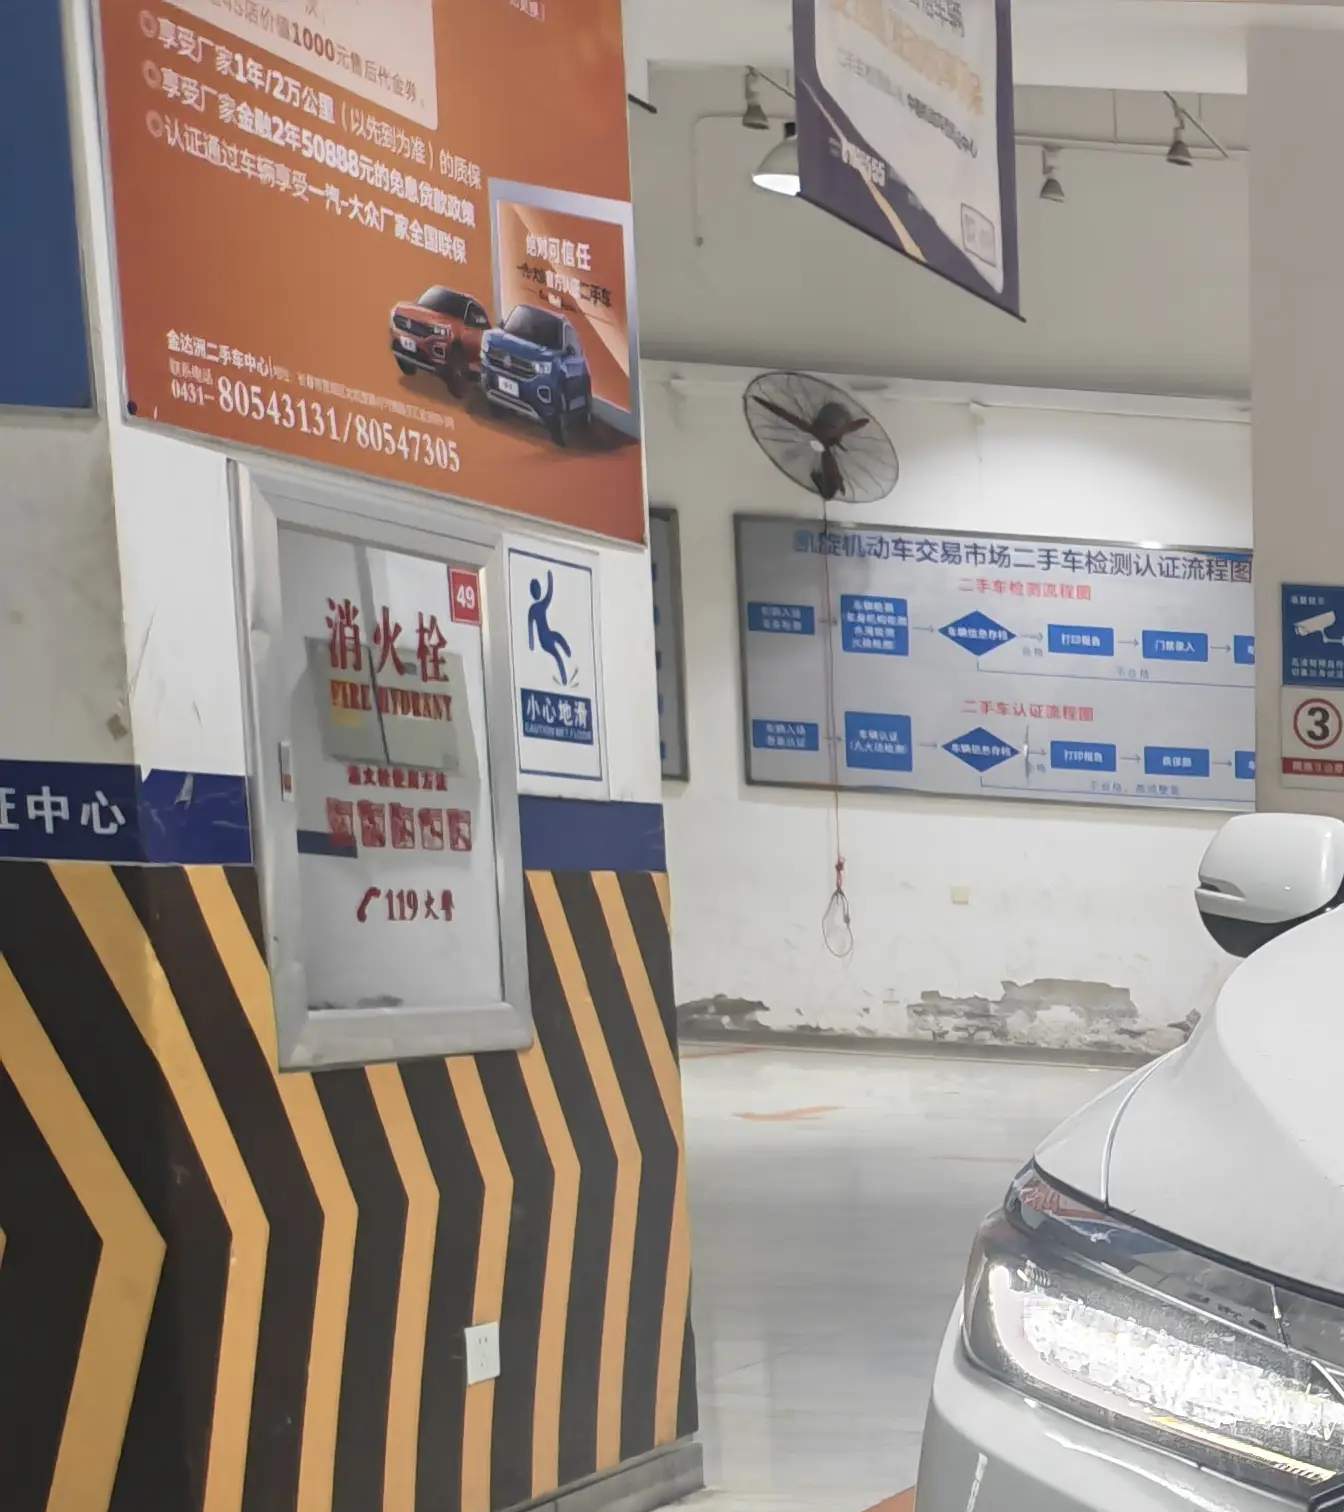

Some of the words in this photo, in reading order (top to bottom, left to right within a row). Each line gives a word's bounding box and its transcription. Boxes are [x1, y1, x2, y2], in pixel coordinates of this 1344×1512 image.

[456, 583, 475, 611] 49
[958, 576, 1092, 601] 二手车检测流程图
[326, 597, 450, 683] 消火栓
[330, 679, 372, 711] FIRE
[526, 692, 588, 730] 小心地滑
[962, 699, 1095, 723] 二手车认证流程图
[1307, 706, 1331, 742] 3
[385, 886, 419, 922] 119
